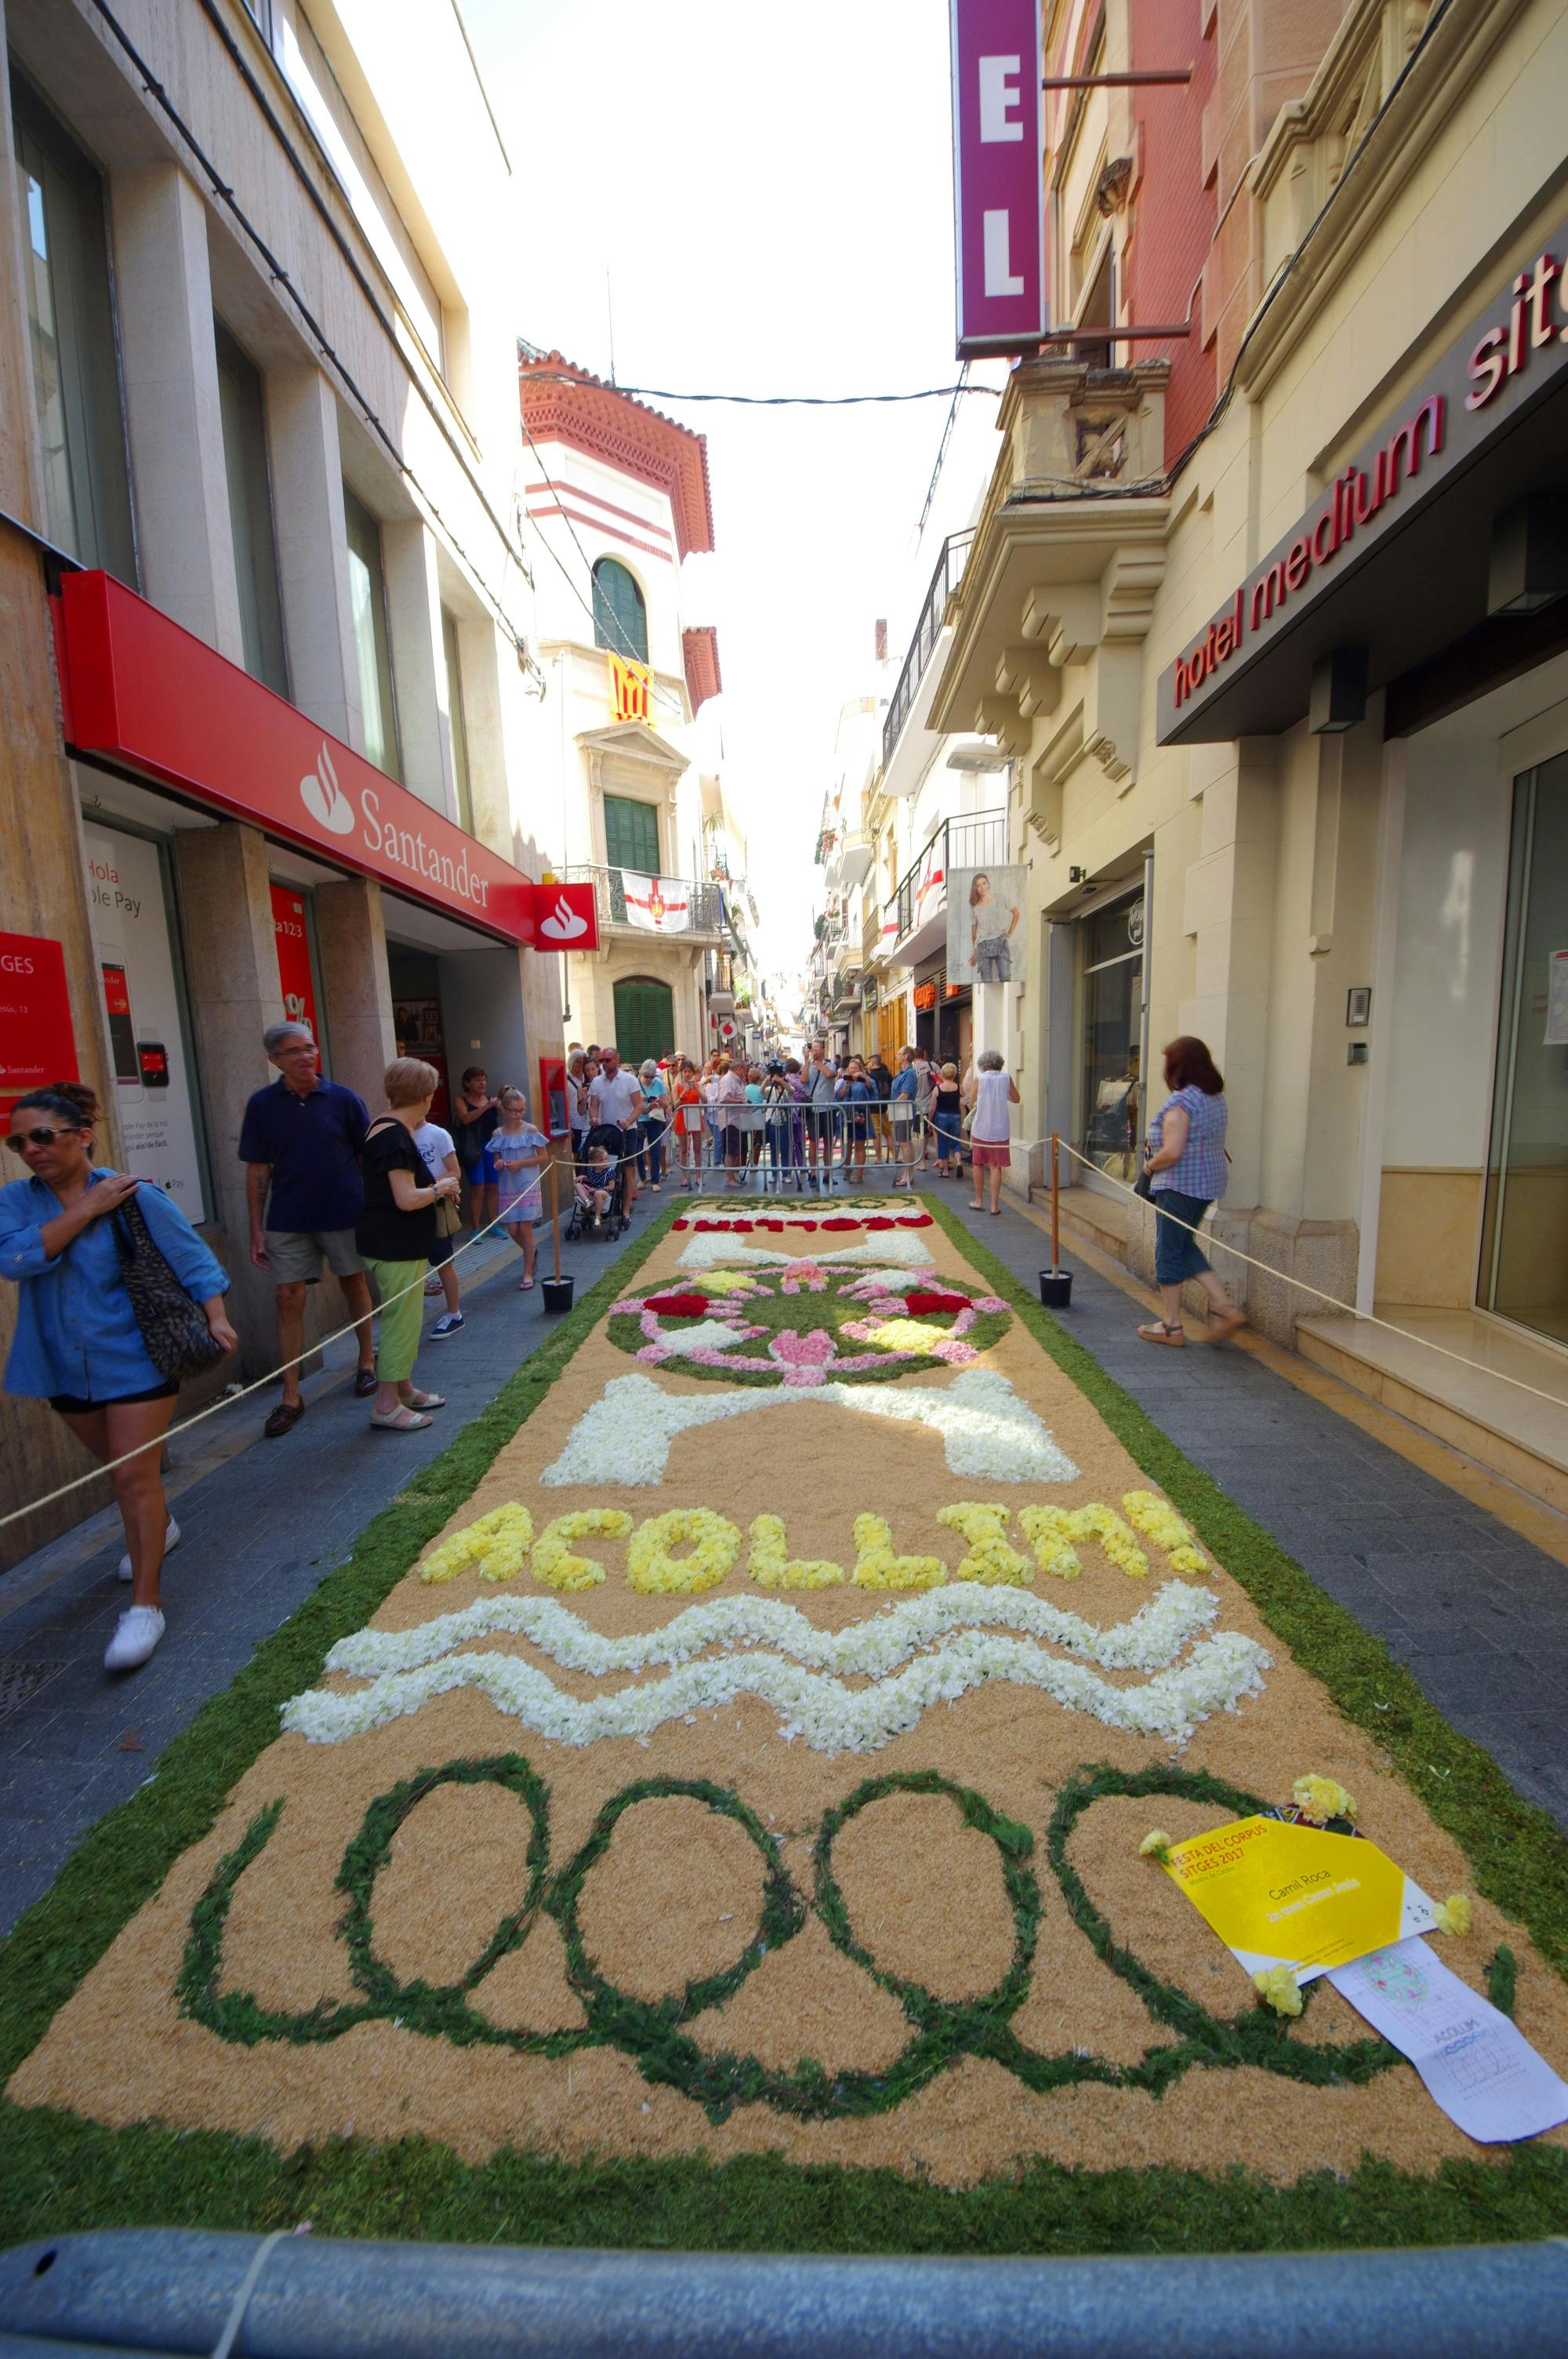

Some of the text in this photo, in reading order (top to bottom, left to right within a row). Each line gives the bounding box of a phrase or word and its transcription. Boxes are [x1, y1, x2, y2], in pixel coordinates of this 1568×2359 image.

[1174, 253, 1568, 708] hotel medium sit
[361, 789, 488, 908] Santander
[115, 891, 140, 918] Pay
[7, 1064, 45, 1074] Santander
[1171, 1824, 1268, 1868] FESTA DEL CORPUS
[1180, 1847, 1245, 1879] SITGES 2017
[1269, 1870, 1331, 1901] Camil Roca
